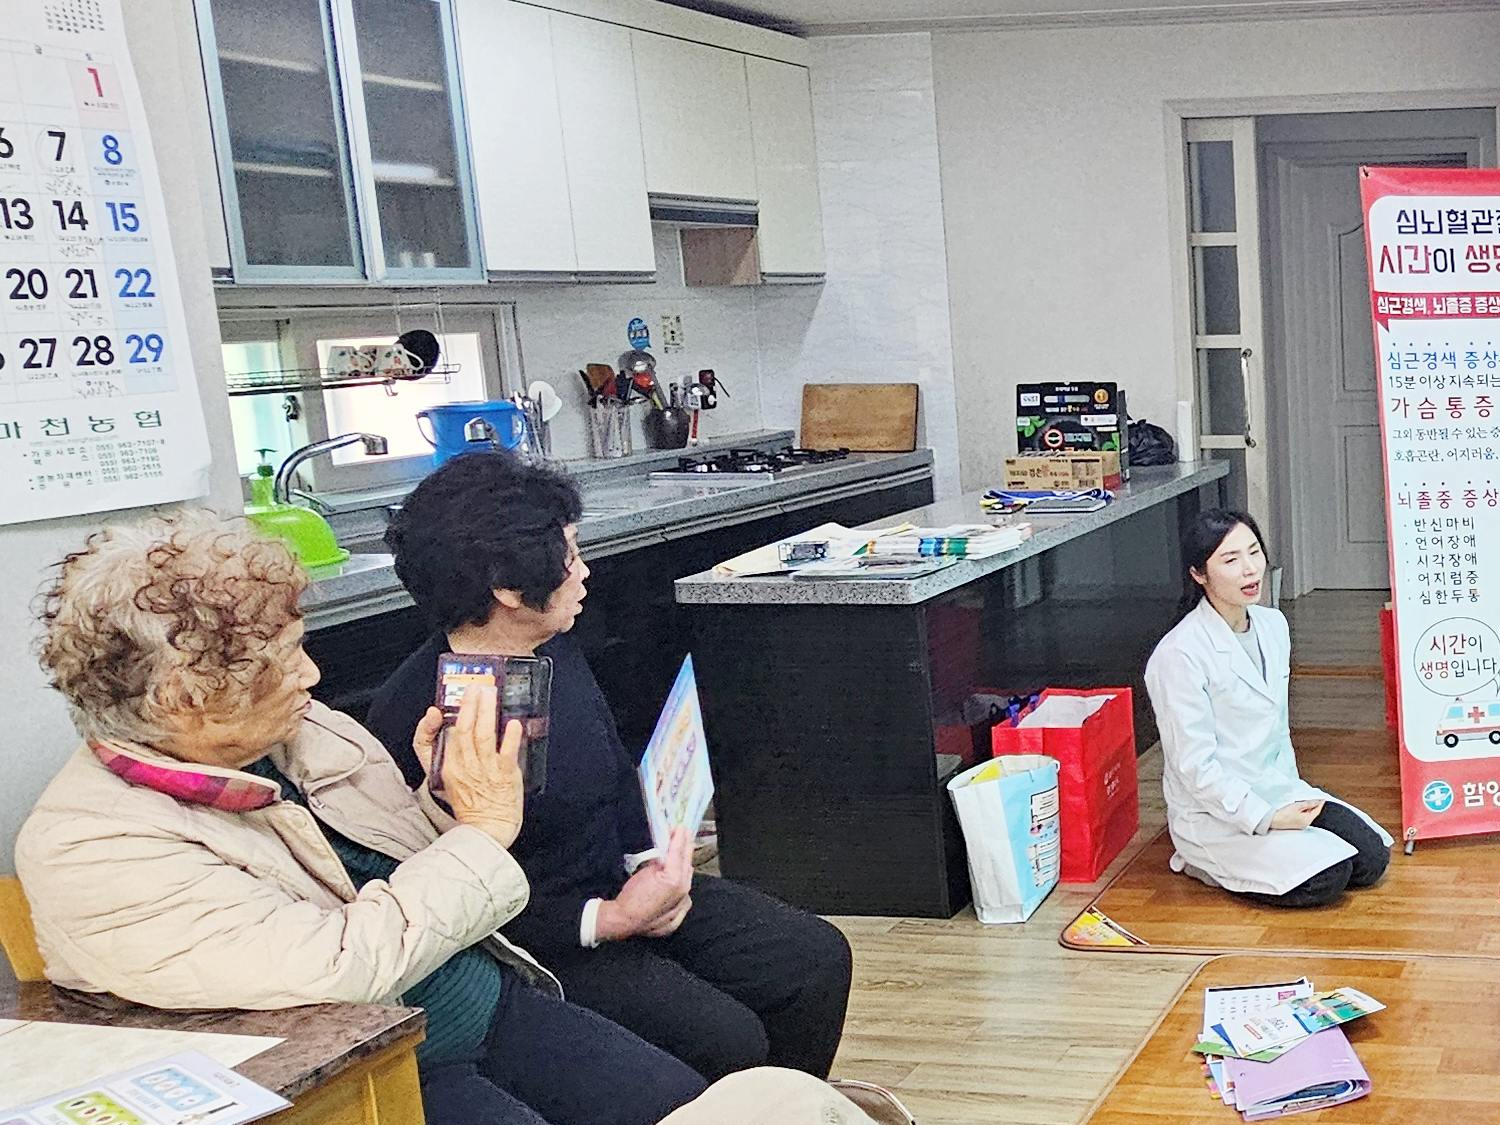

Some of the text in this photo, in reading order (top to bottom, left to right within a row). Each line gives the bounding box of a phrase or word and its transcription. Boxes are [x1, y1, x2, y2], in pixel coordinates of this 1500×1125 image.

[87, 67, 104, 97] 1
[47, 131, 66, 161] 7
[102, 134, 123, 165] 8
[0, 197, 140, 232] 13 14 15
[1378, 245, 1456, 275] 시간이
[6, 268, 156, 300] 20 21 22
[19, 333, 164, 369] 27 28 29
[1387, 350, 1458, 371] 심근경색
[1389, 375, 1416, 390] 15분
[1419, 374, 1446, 390] 이상
[1391, 395, 1495, 421] 가슴통증
[1452, 428, 1463, 440] 수
[1466, 426, 1488, 440] 있는
[1397, 490, 1453, 510] 뇌졸중
[1414, 516, 1475, 533] 반신마비
[1415, 534, 1476, 551] 언어장애
[1417, 551, 1478, 568] 시각장애
[1418, 570, 1479, 587] 어지럼증
[1420, 588, 1481, 605] 심한두통
[1429, 634, 1484, 657] 시간이
[1418, 656, 1498, 681] 생명입니다
